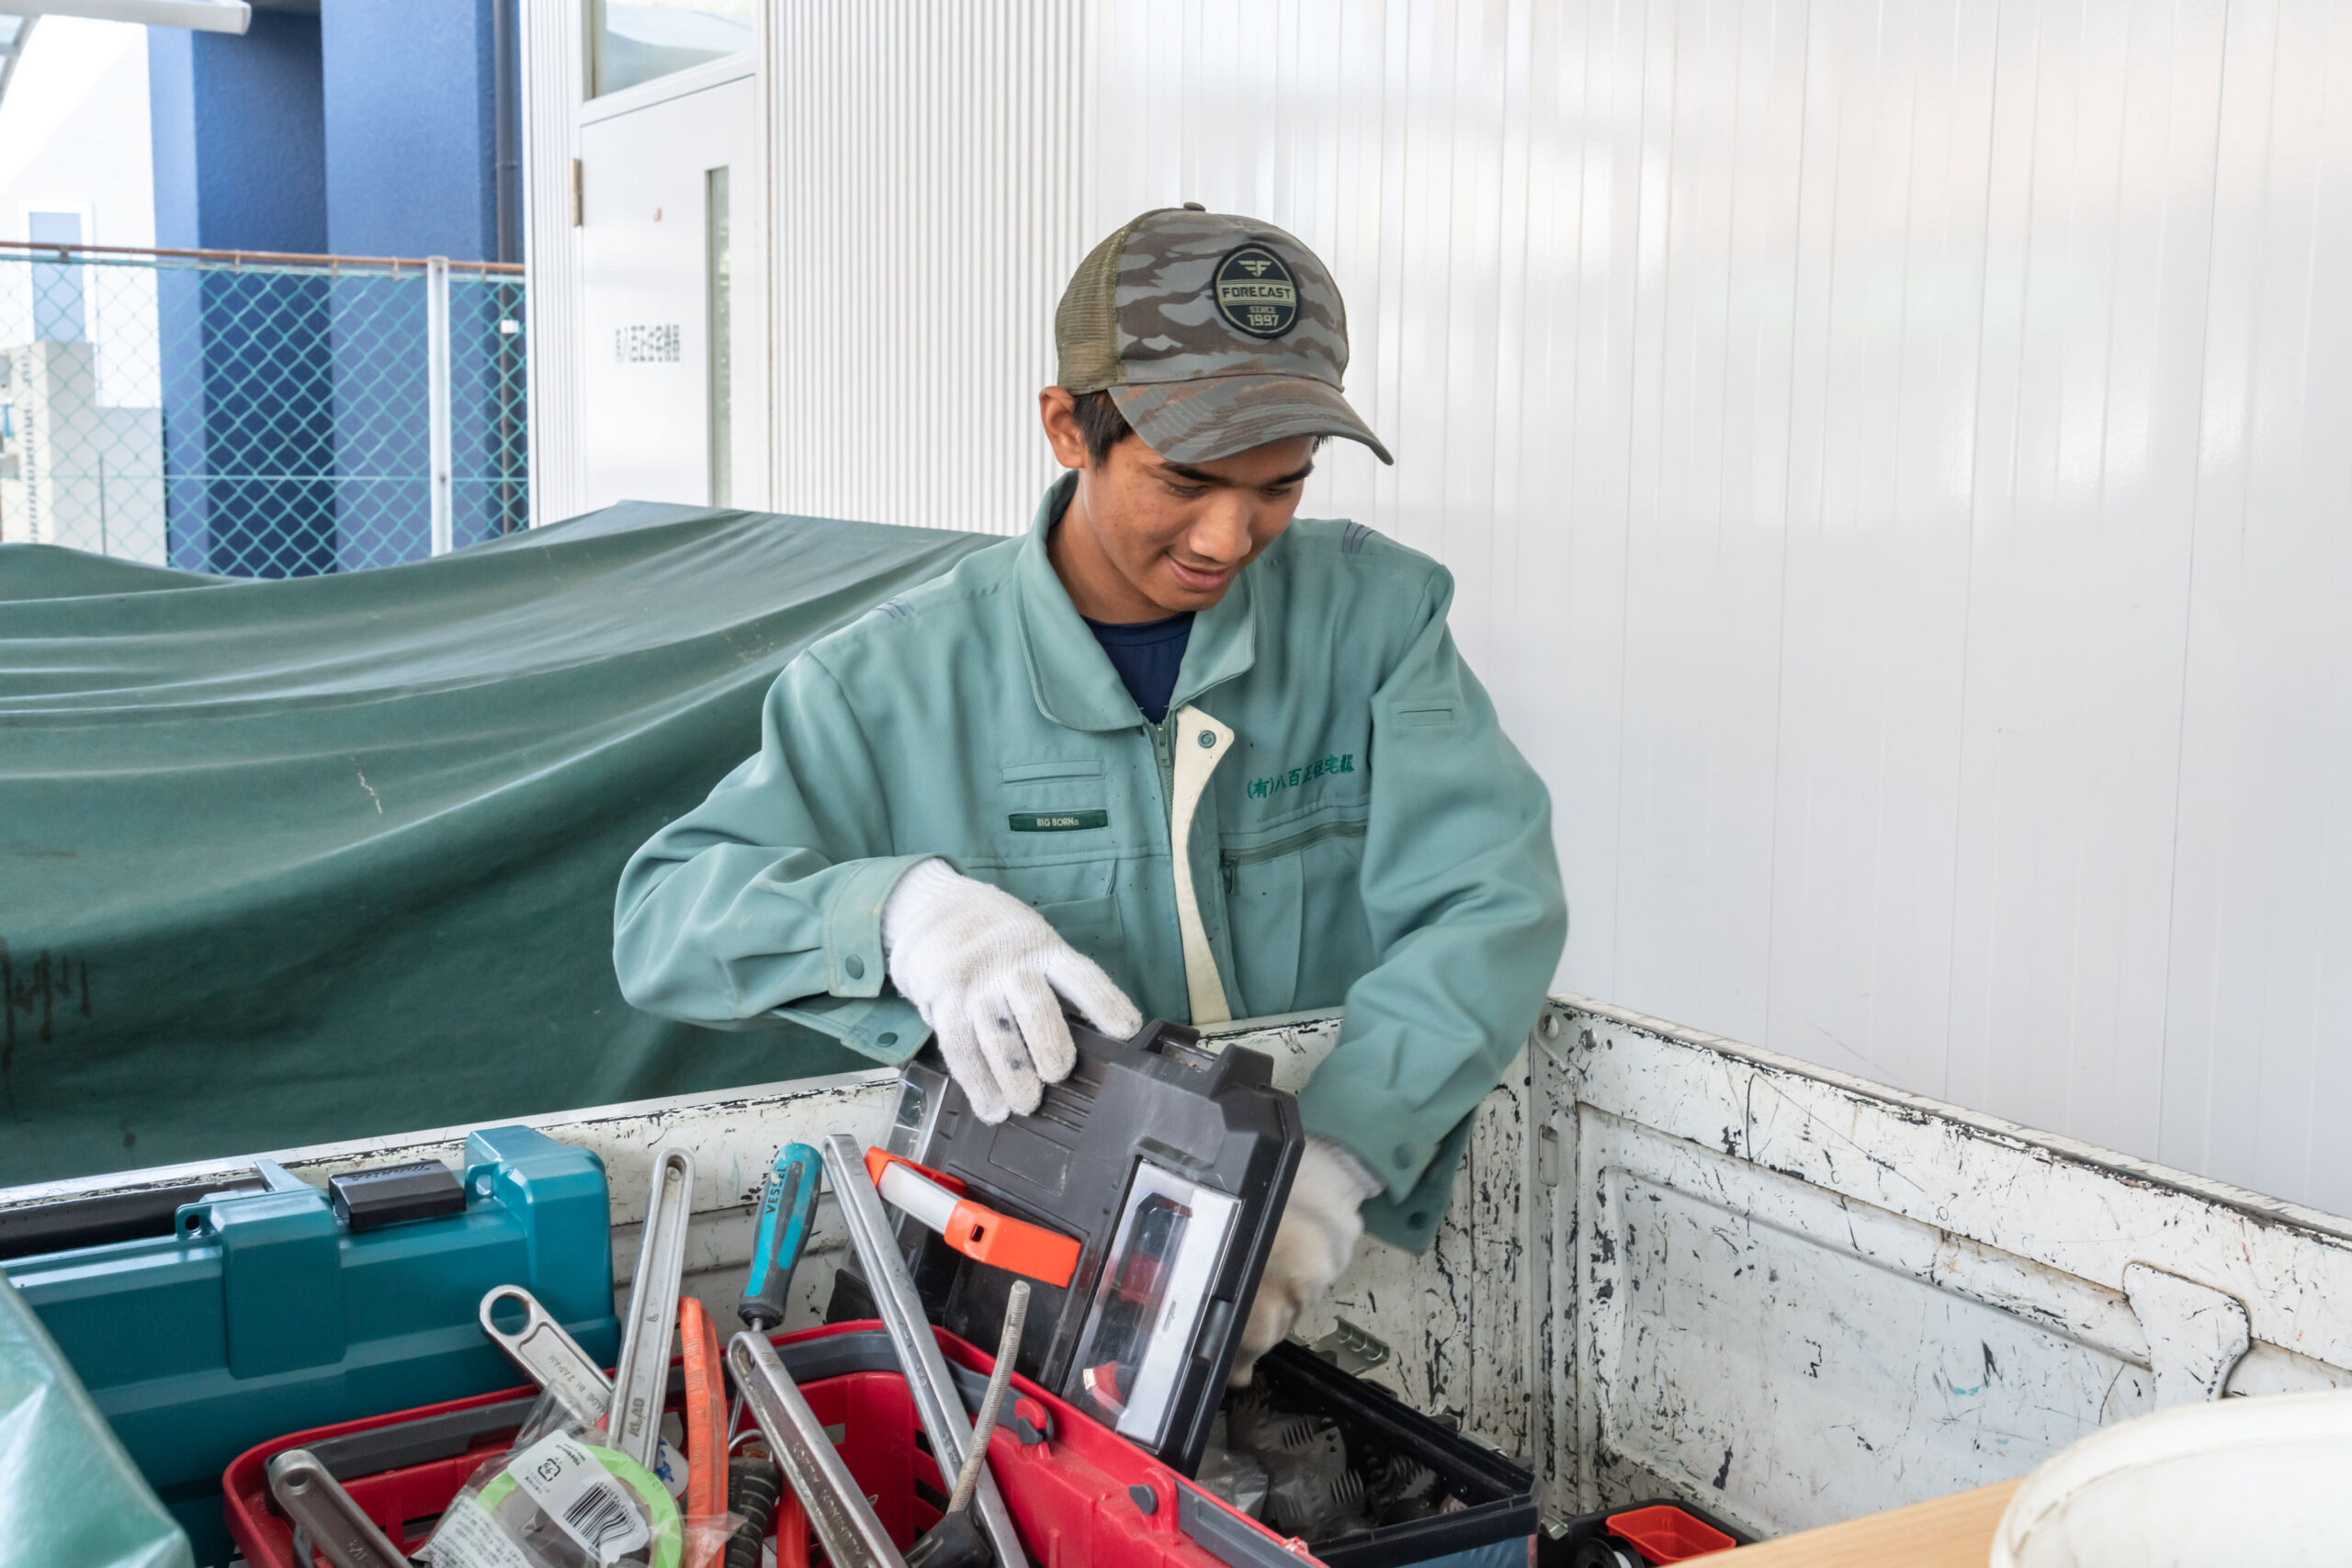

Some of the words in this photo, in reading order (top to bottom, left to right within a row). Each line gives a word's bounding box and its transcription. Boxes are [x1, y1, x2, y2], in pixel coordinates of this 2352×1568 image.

[1222, 287, 1291, 299] FORECAST
[1250, 306, 1277, 314] SINCE
[1247, 314, 1280, 326] 1997
[1036, 818, 1051, 827] BIG
[1052, 817, 1074, 827] BORN
